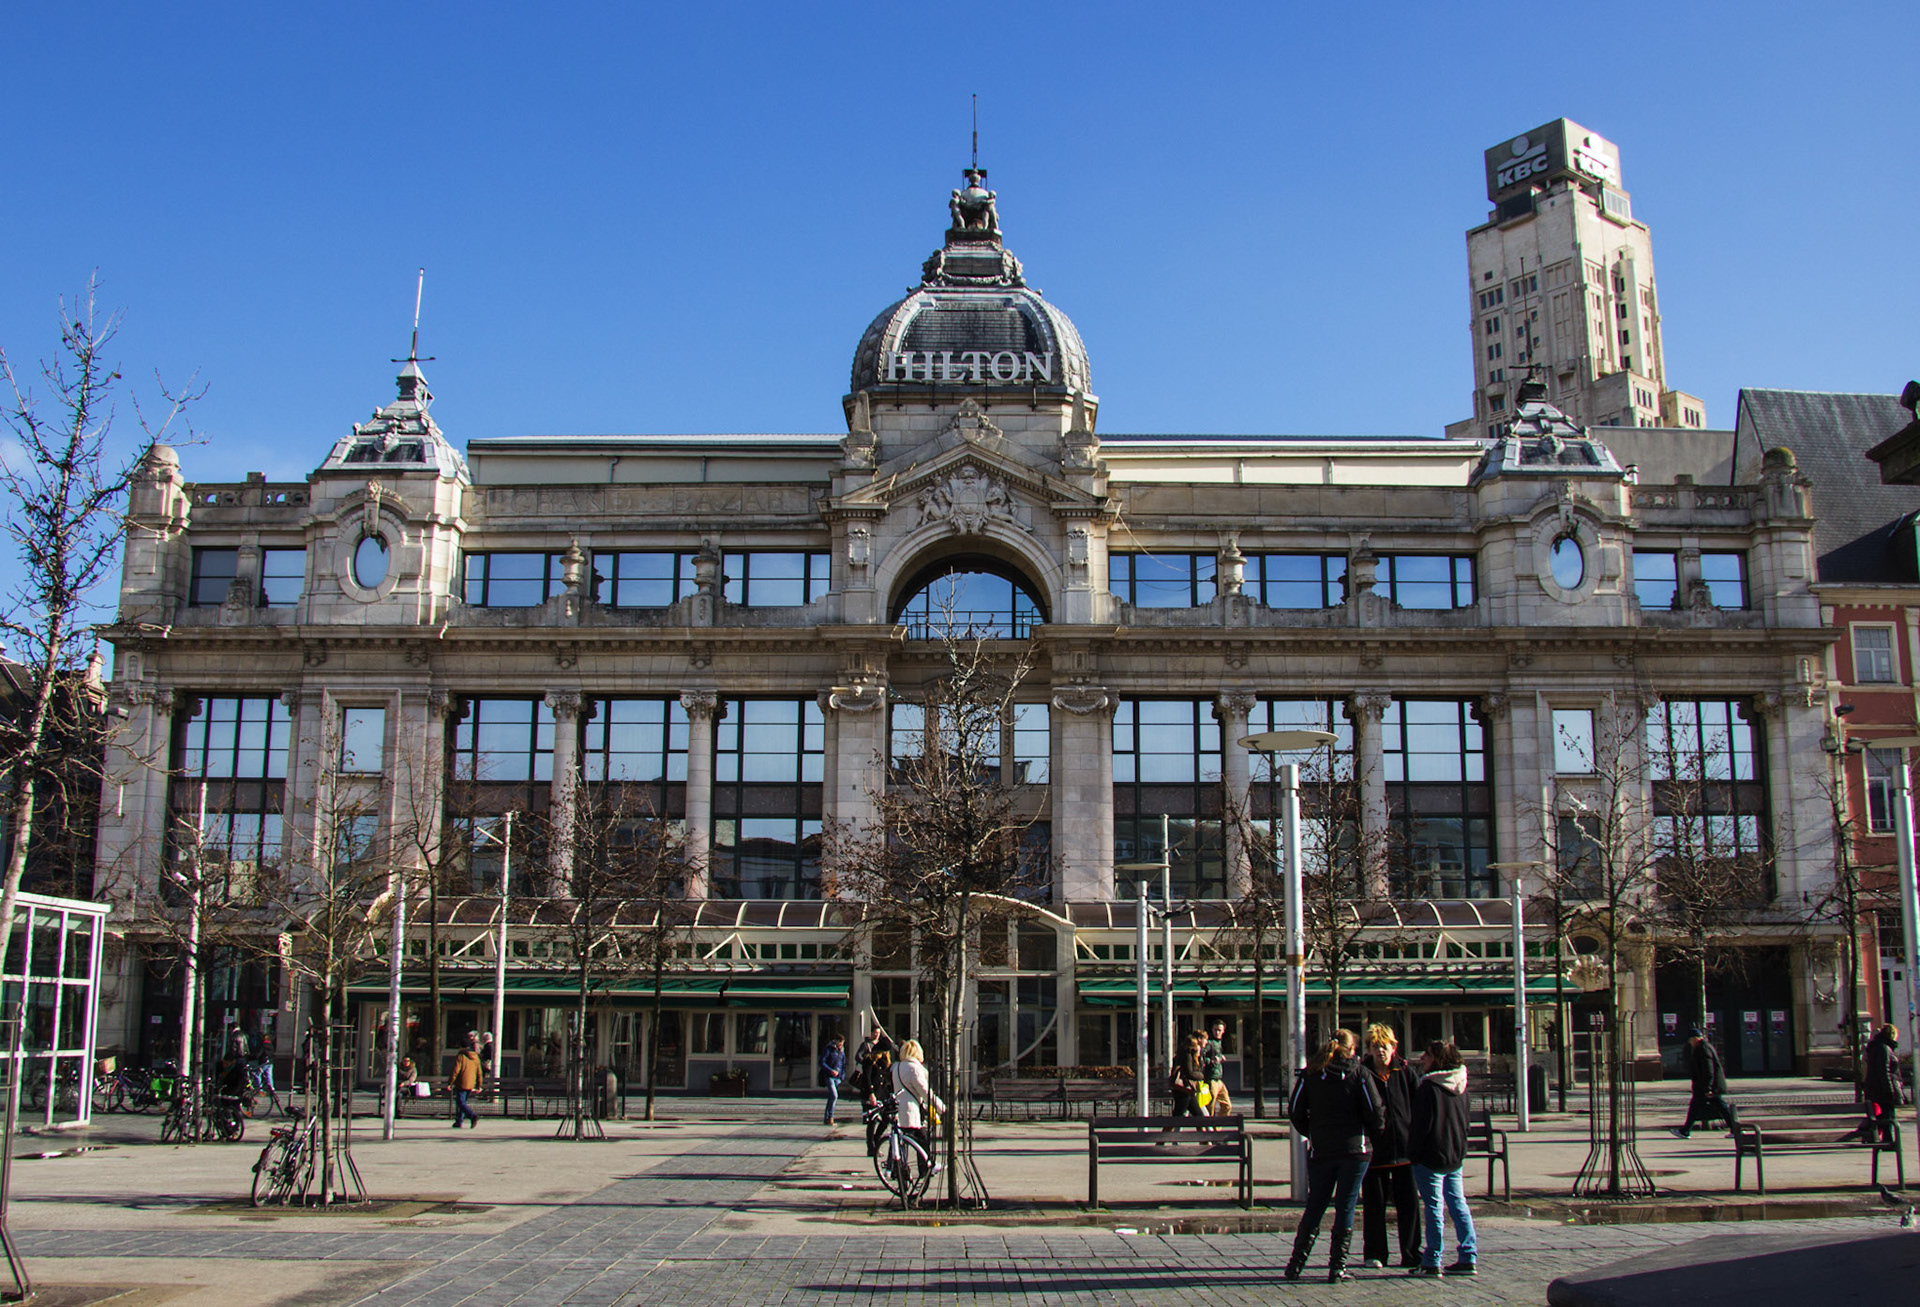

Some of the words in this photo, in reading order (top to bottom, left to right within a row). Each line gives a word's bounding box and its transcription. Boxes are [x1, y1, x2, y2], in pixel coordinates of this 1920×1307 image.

[1497, 154, 1549, 188] KBC
[1578, 153, 1617, 186] KBC
[885, 351, 1054, 382] HILTON
[510, 492, 633, 513] GRAND
[674, 490, 785, 512] BAZAR
